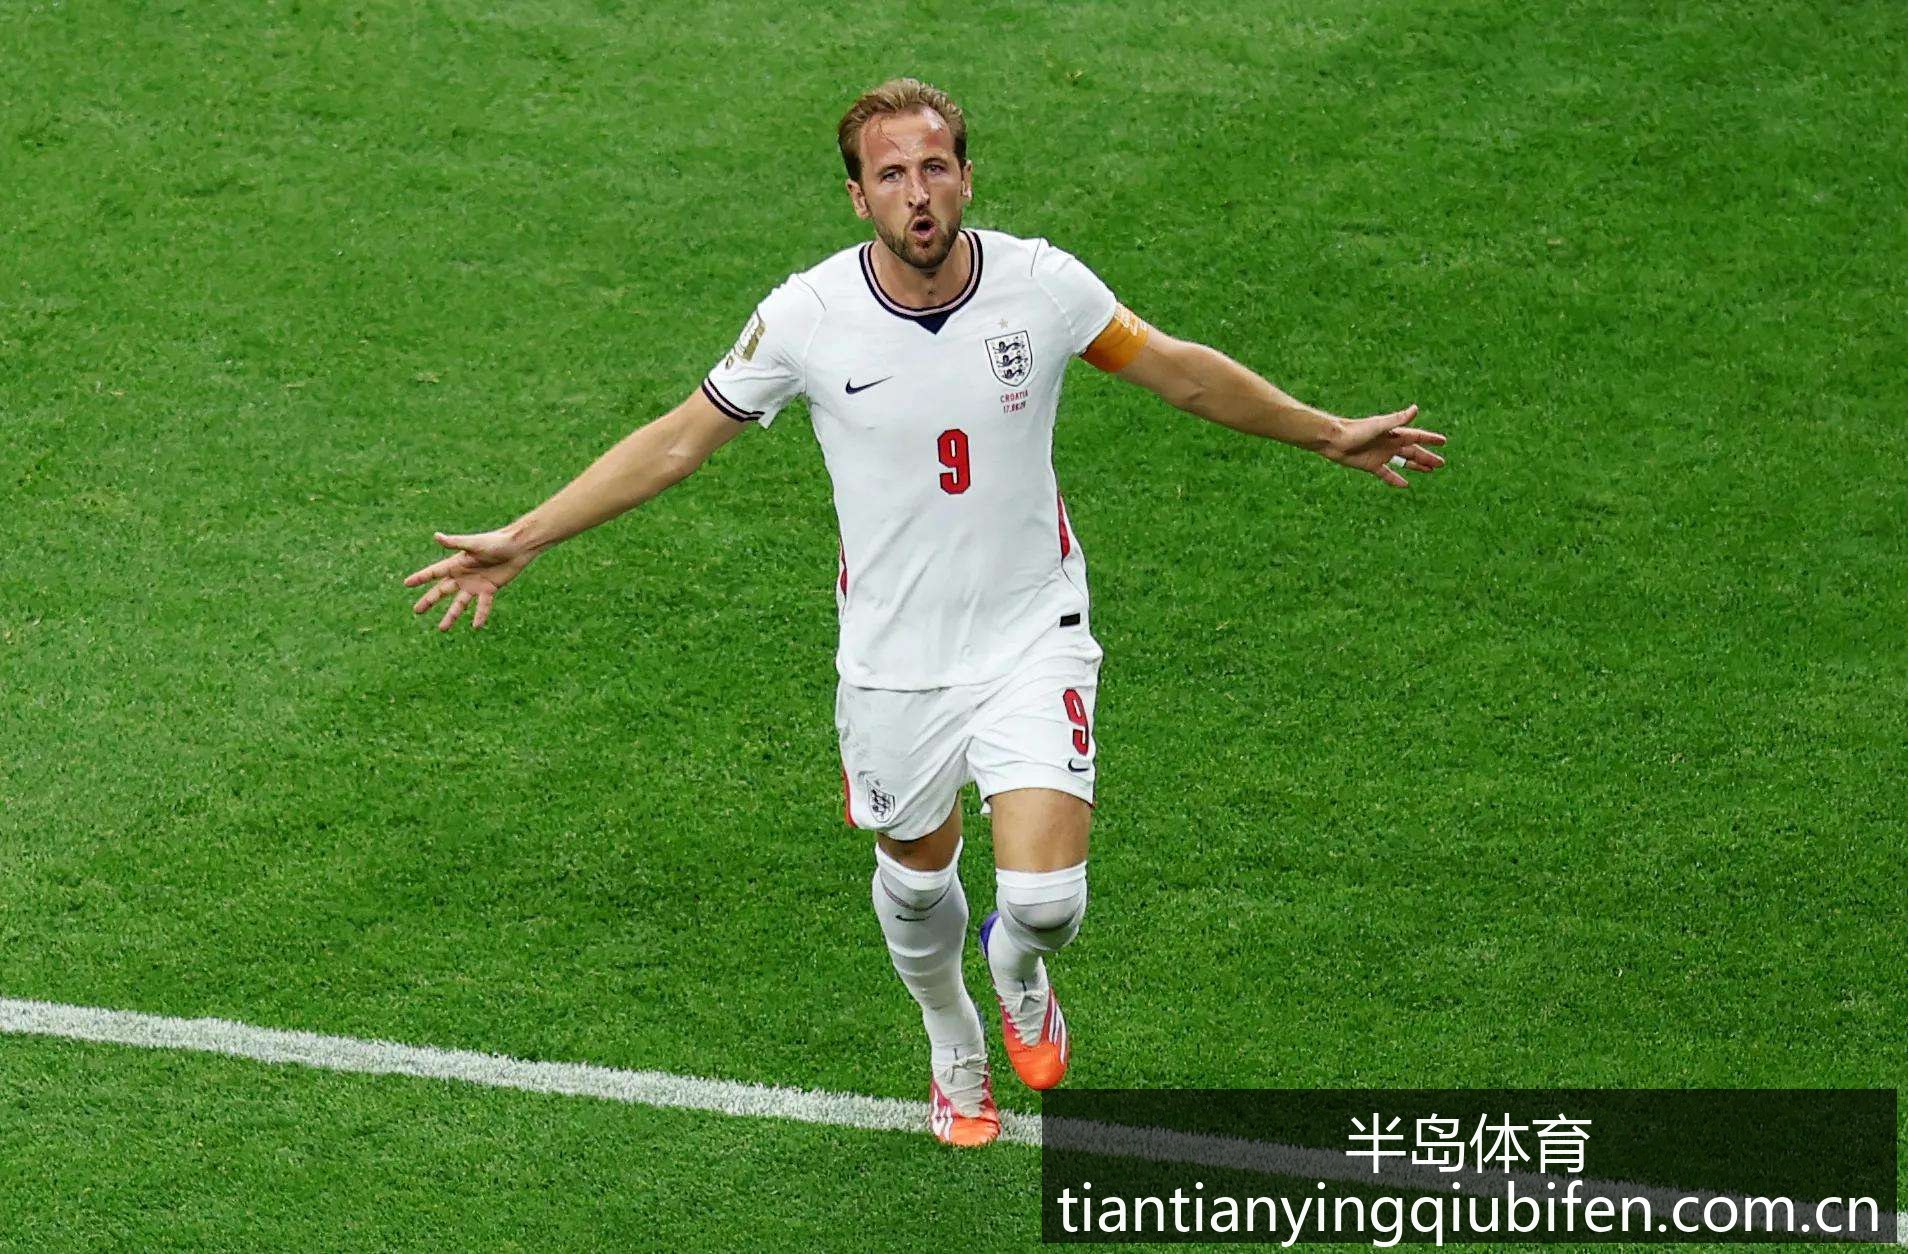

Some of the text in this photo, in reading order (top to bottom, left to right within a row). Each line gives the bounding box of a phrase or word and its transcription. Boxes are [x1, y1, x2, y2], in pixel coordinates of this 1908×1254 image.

[1000, 389, 1028, 403] CROATIA
[937, 429, 971, 494] 9
[1063, 688, 1089, 756] 9
